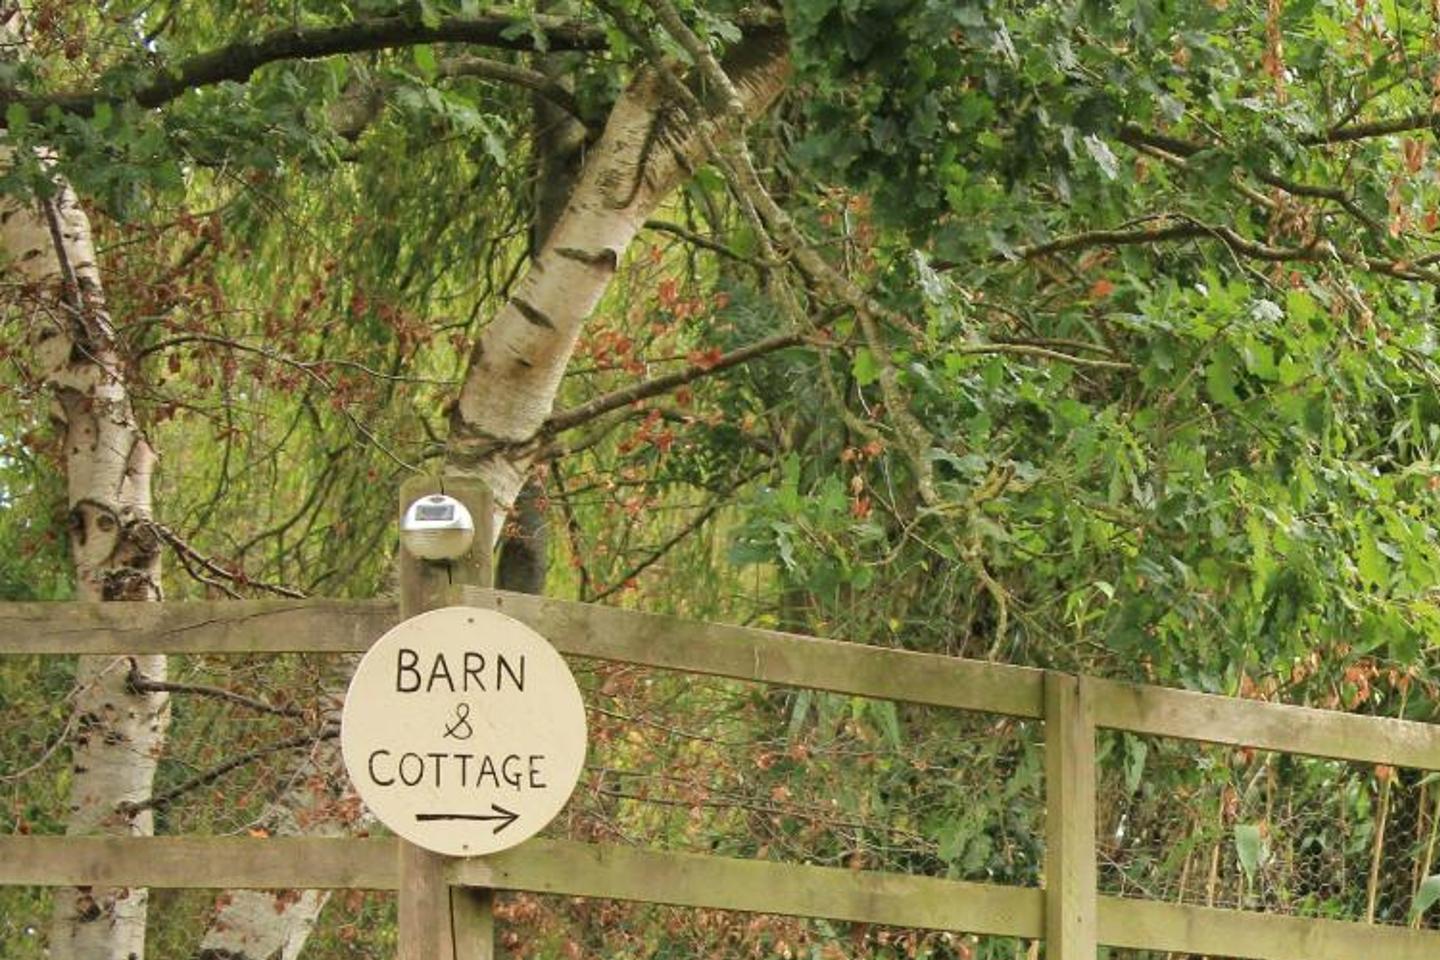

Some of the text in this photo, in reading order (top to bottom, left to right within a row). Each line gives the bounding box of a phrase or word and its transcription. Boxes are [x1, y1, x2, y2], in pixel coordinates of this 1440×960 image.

[396, 648, 526, 693] BARN
[442, 702, 474, 741] &
[367, 749, 548, 792] COTTAGE
